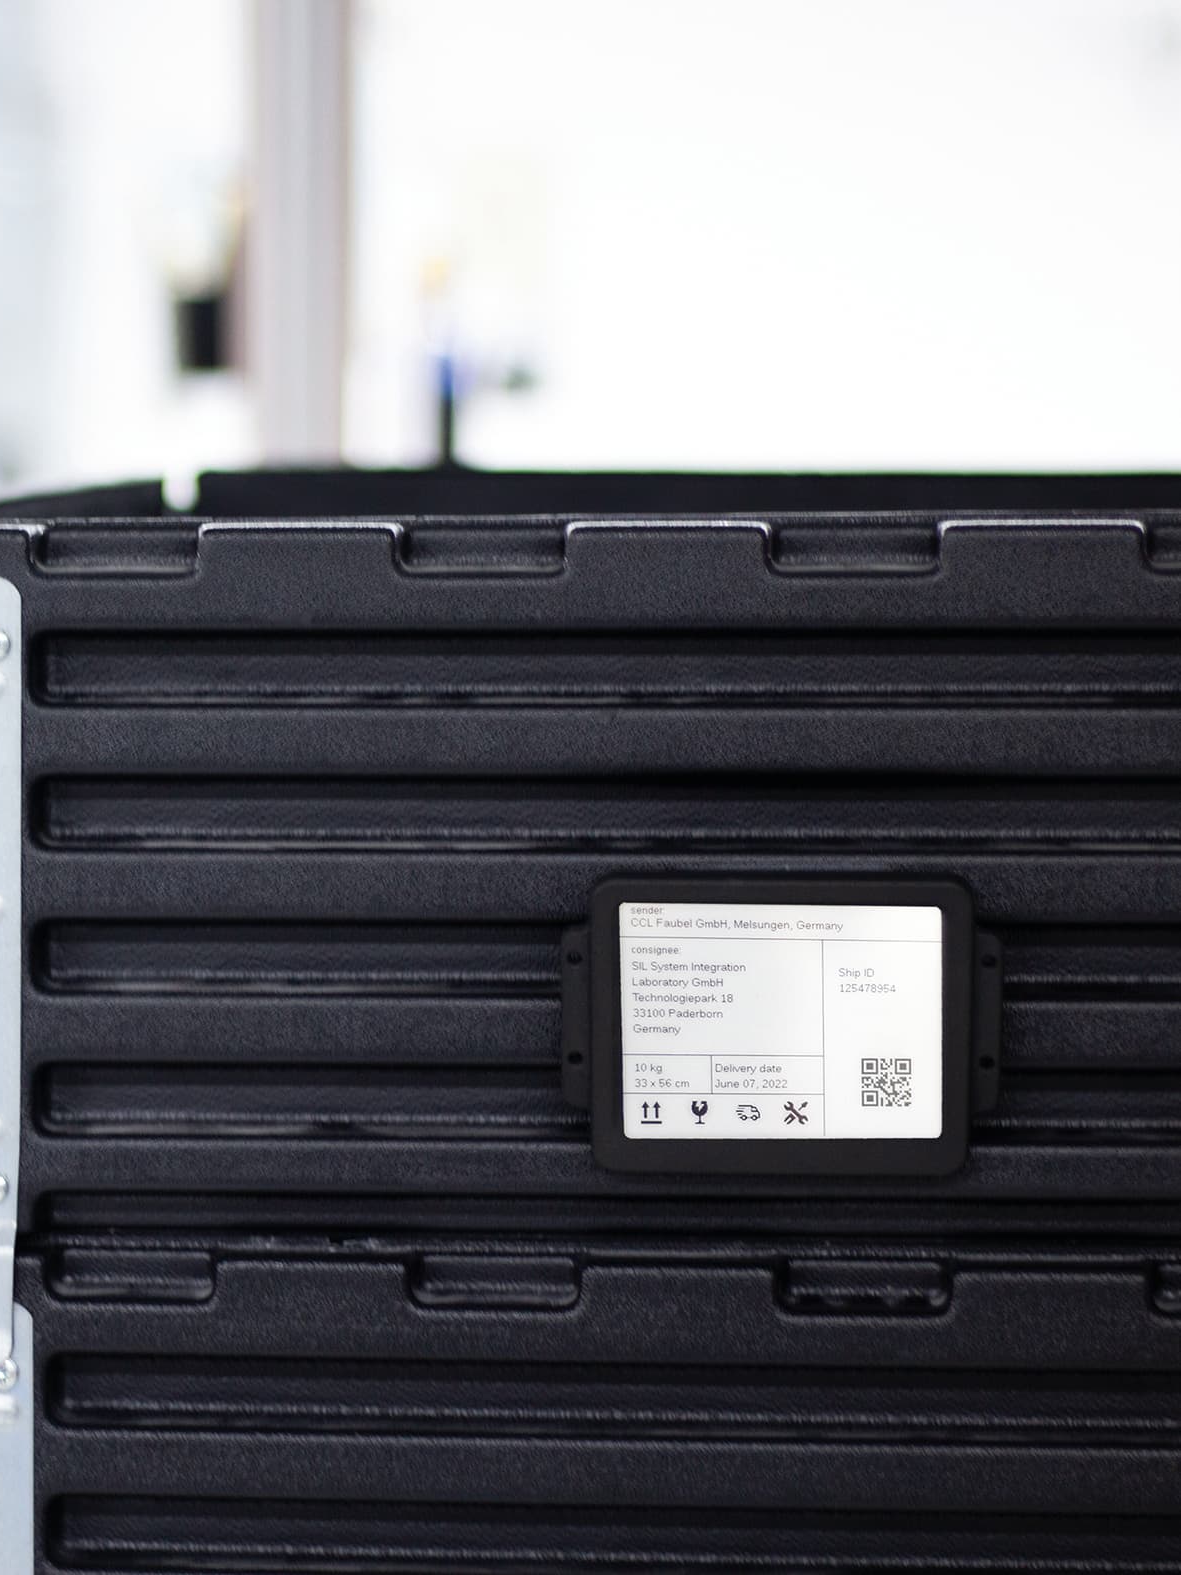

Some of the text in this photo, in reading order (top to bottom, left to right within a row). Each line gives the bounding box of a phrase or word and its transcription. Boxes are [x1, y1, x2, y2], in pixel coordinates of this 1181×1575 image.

[630, 917, 844, 934] CCL Faubel GmbH, Melsungen, Germany
[631, 961, 747, 975] SIL System Integration
[837, 968, 875, 980] Ship ID
[631, 977, 724, 990] Laboratory GmbH
[839, 984, 897, 994] 125478954
[631, 993, 734, 1006] Technologiepark 18
[632, 1008, 724, 1019] 33100 Paderborn
[633, 1024, 682, 1037] Germany
[634, 1063, 663, 1076] 10 kg
[715, 1063, 783, 1076] Delivery date
[634, 1078, 691, 1089] 33 x 56 cm
[714, 1078, 788, 1091] June 07, 2022
